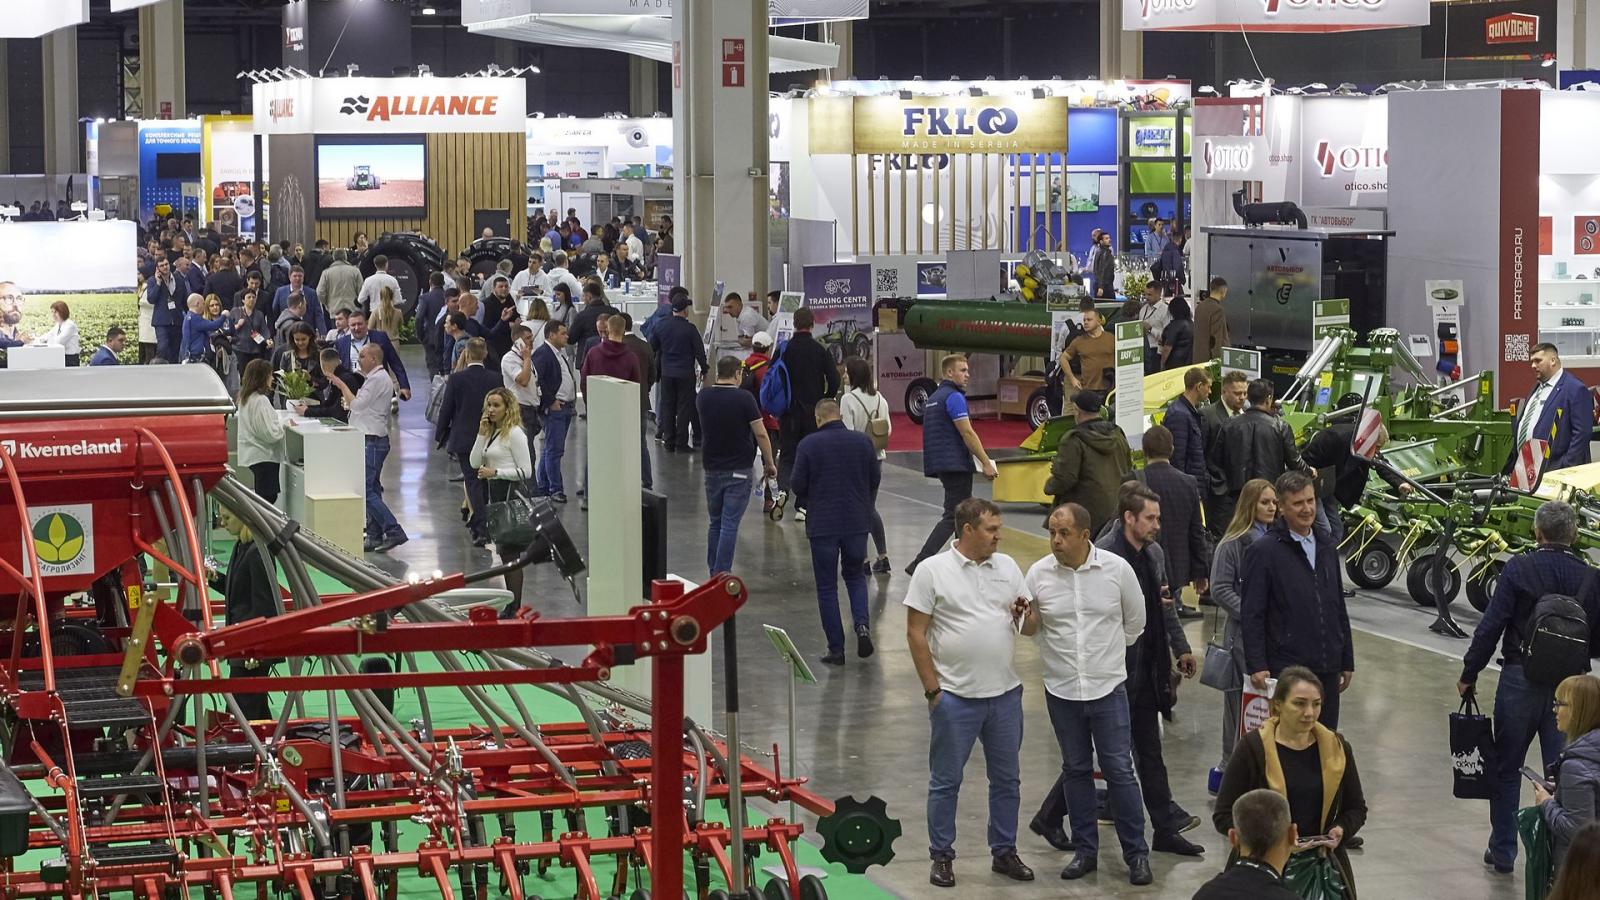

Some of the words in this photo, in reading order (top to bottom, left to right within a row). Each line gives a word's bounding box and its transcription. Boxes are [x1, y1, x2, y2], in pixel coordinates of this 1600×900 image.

[1488, 19, 1534, 39] QUIVOGNE
[367, 96, 499, 121] ALLIANCE
[1213, 149, 1249, 168] OTICO
[1311, 216, 1318, 224] ГК
[1514, 227, 1523, 320] PARTSAGRO.RU
[809, 297, 842, 305] TRADING
[20, 438, 122, 458] Kverneland
